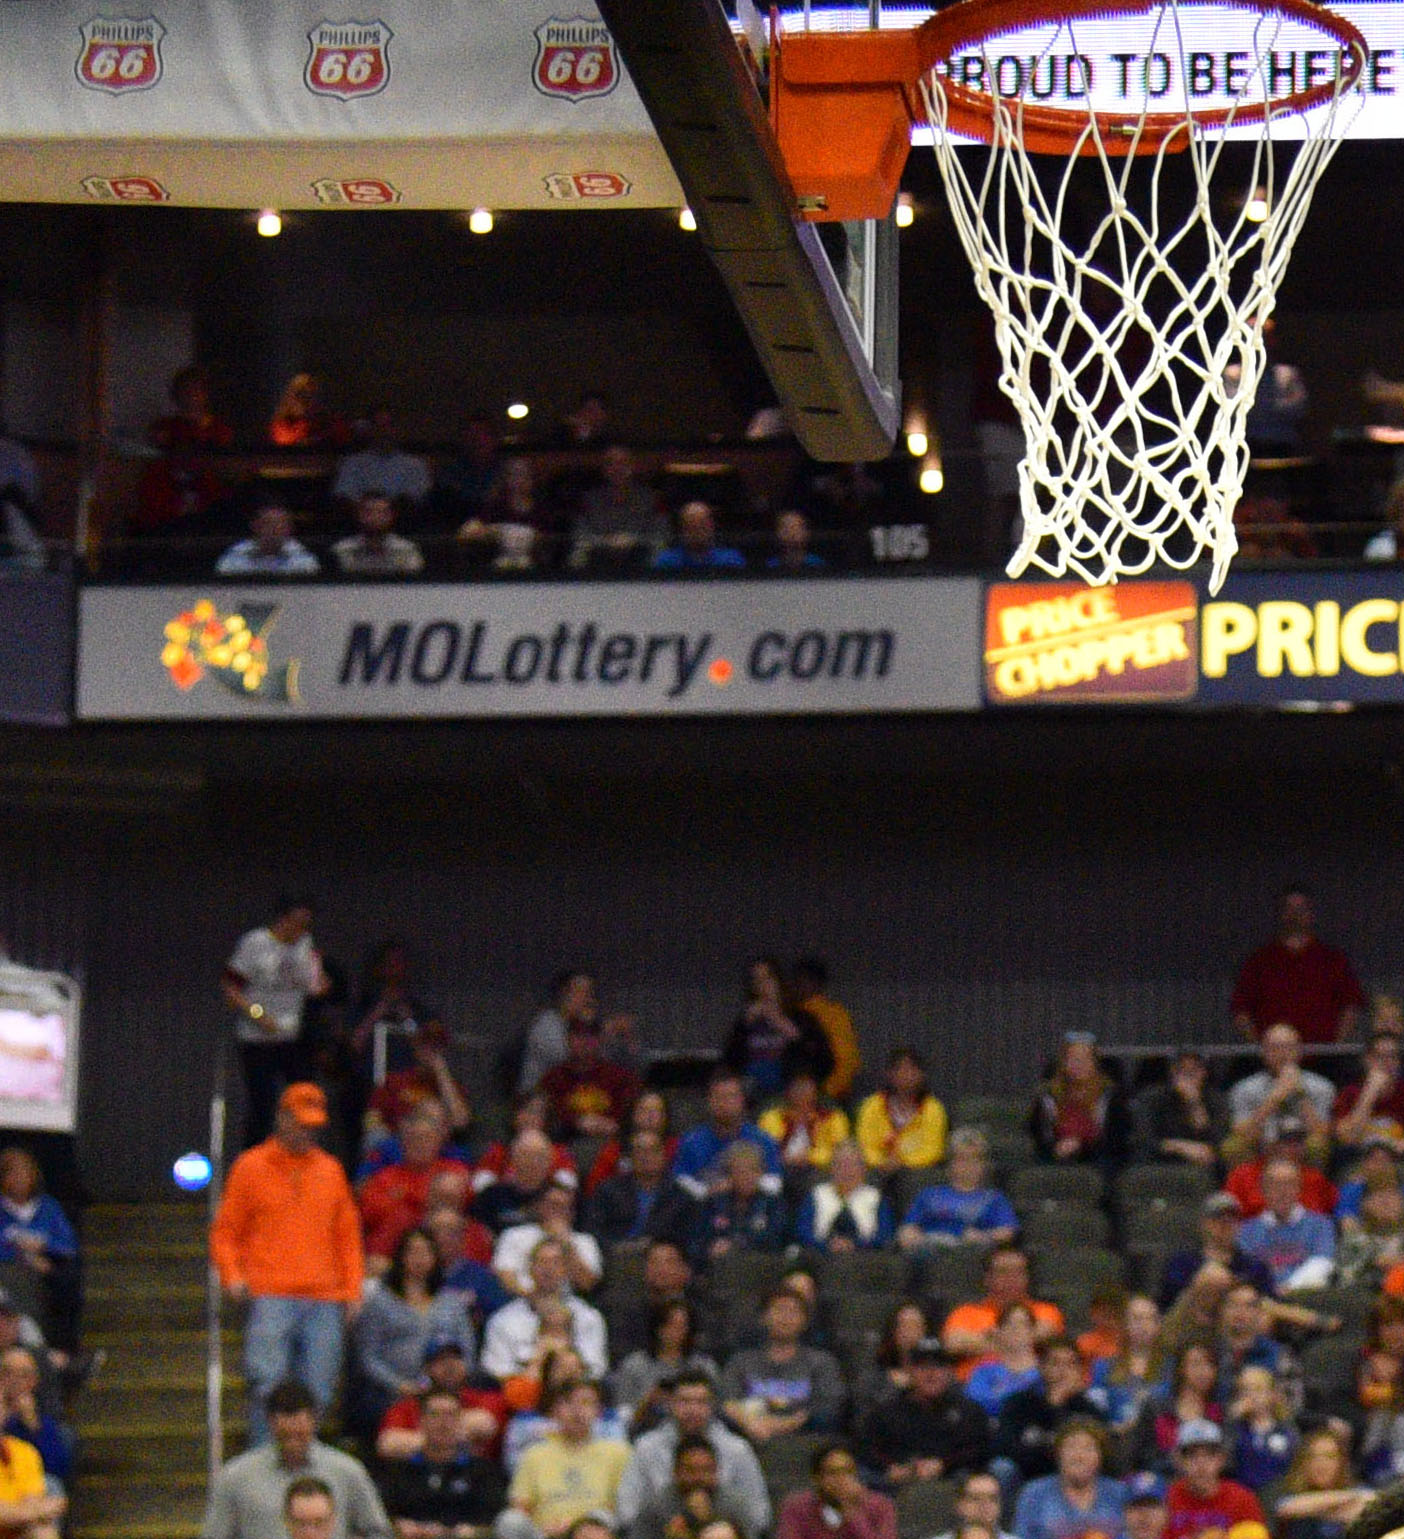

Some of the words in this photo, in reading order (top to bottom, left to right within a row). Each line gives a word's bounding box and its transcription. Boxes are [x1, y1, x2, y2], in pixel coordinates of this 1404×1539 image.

[91, 24, 154, 42] PHILLIPS
[319, 30, 381, 46] PHILLIPS
[90, 49, 147, 80] 66
[319, 51, 375, 84] 66
[547, 50, 602, 83] 66
[1107, 53, 1174, 99] TO
[1190, 51, 1255, 98] BE
[999, 588, 1119, 645] PRICE
[339, 619, 895, 698] MOLottery.com
[995, 622, 1189, 697] CHOPPER
